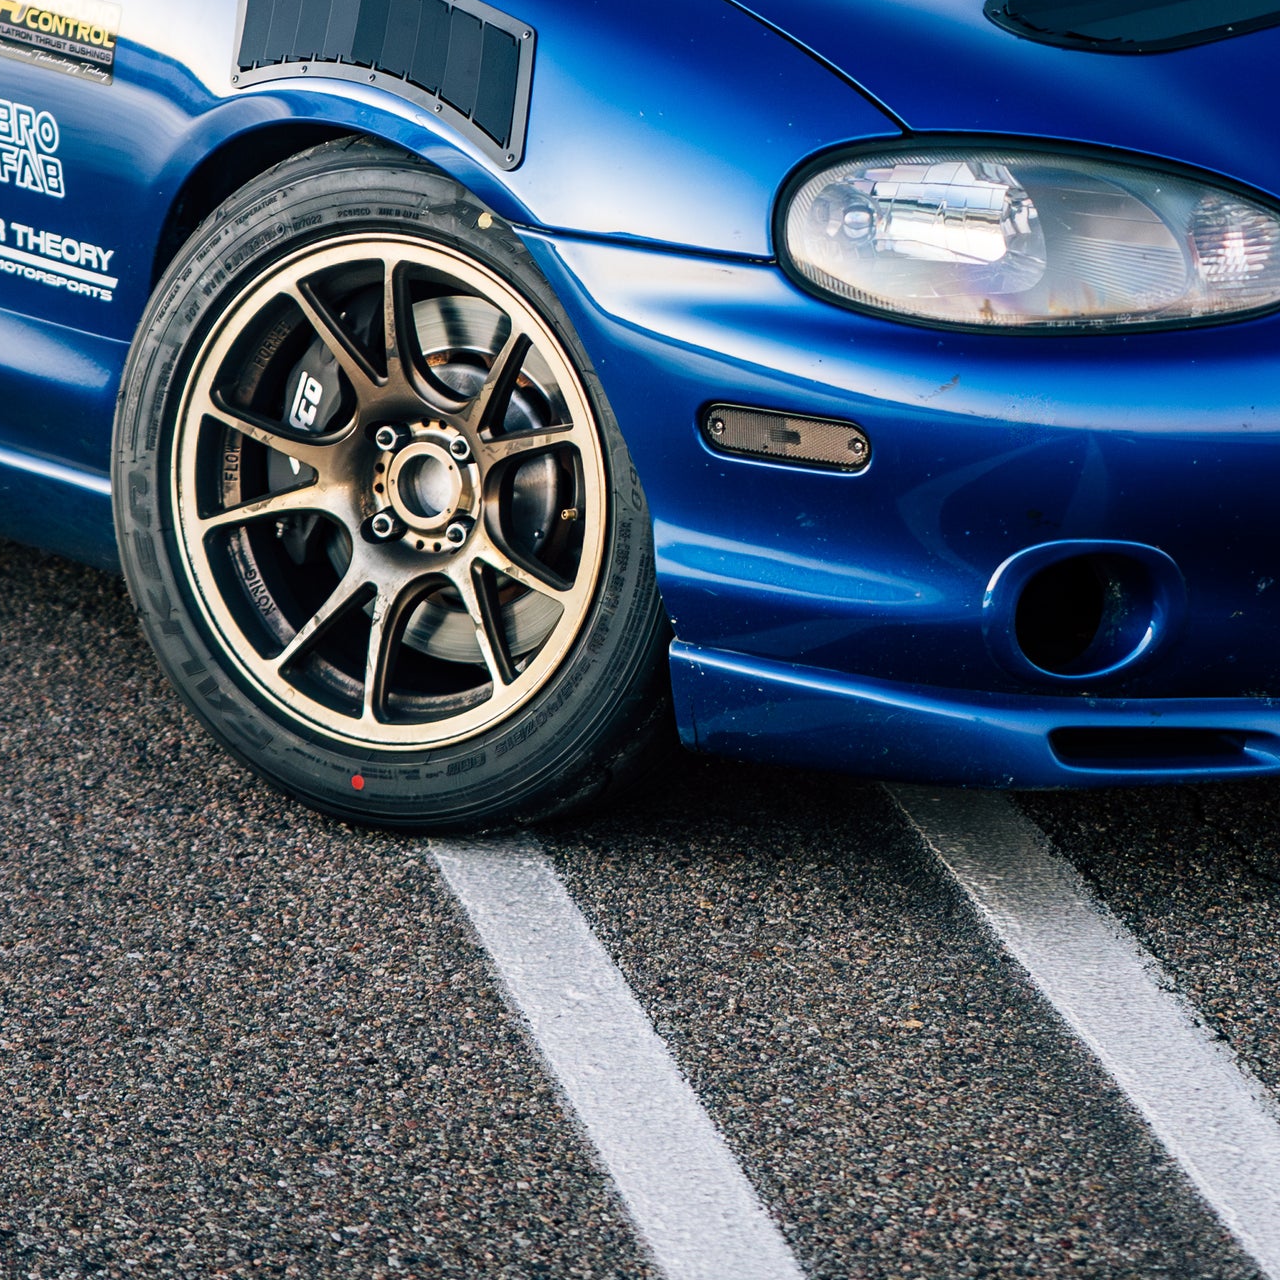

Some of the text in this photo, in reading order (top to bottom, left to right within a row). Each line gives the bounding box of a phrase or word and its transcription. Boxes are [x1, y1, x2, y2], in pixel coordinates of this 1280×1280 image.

[25, 7, 115, 49] CONTROL
[35, 35, 67, 50] THRUST
[69, 44, 111, 62] BUSHINGS
[80, 62, 110, 81] Today
[10, 222, 114, 271] THEORY
[156, 285, 181, 323] TREADWEAR
[196, 236, 222, 263] TRACTION
[234, 195, 278, 226] TEMPERATURE
